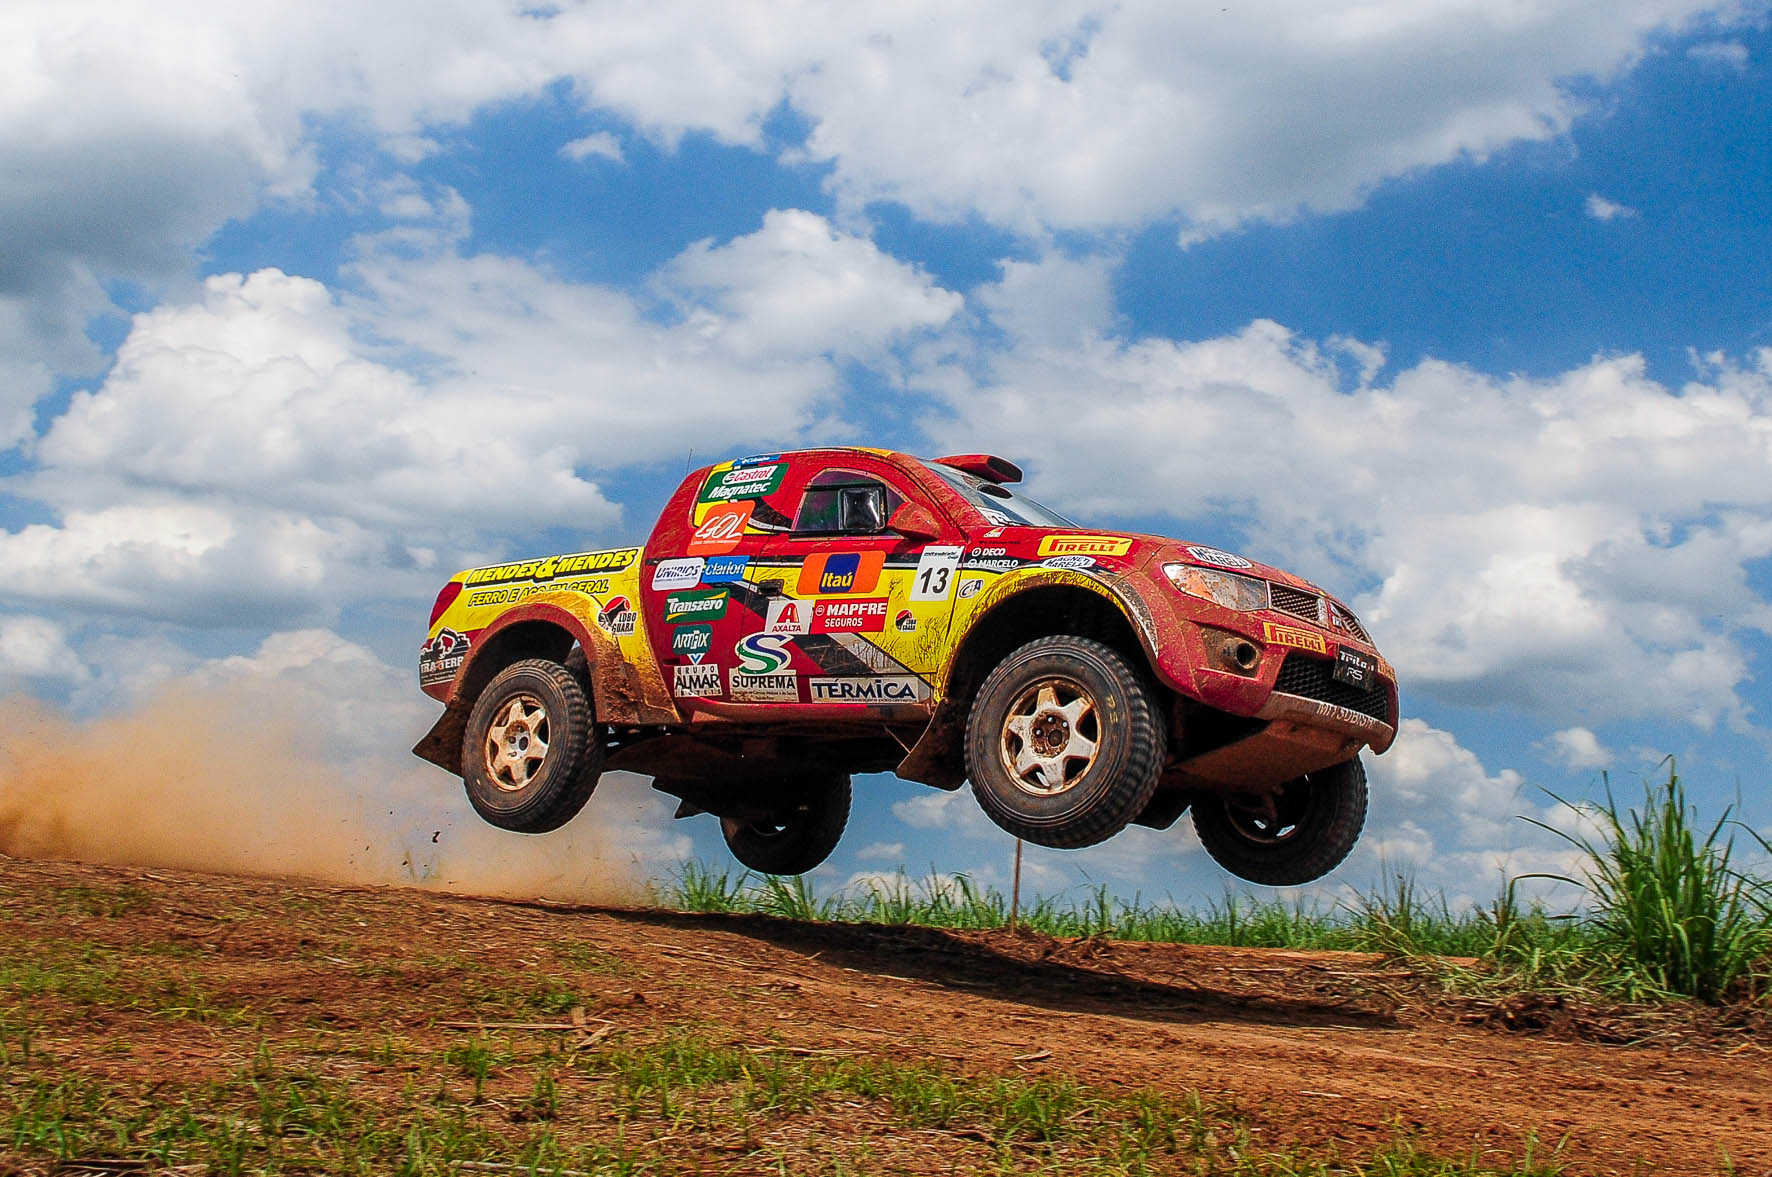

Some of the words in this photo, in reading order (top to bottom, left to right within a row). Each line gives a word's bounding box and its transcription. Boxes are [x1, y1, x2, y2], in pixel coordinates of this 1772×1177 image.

[733, 468, 772, 481] Castrol
[708, 482, 771, 499] Magnatec
[695, 512, 746, 539] GOL
[1049, 539, 1119, 551] PIRELLI
[982, 548, 1006, 556] DECO
[979, 560, 1019, 568] MARCELO
[822, 572, 853, 587] Itaú
[920, 567, 950, 594] 13
[468, 591, 507, 606] FERRO
[508, 589, 518, 602] E
[569, 580, 608, 594] GERAL
[667, 598, 723, 613] Transzero
[827, 603, 887, 616] MAPFRE
[772, 623, 802, 632] AXALTA
[825, 618, 863, 627] SEGUROS
[1270, 626, 1322, 651] PIRELLI
[677, 666, 715, 674] GRUPO
[675, 674, 719, 689] ALMAR
[732, 676, 795, 689] SUPREMA
